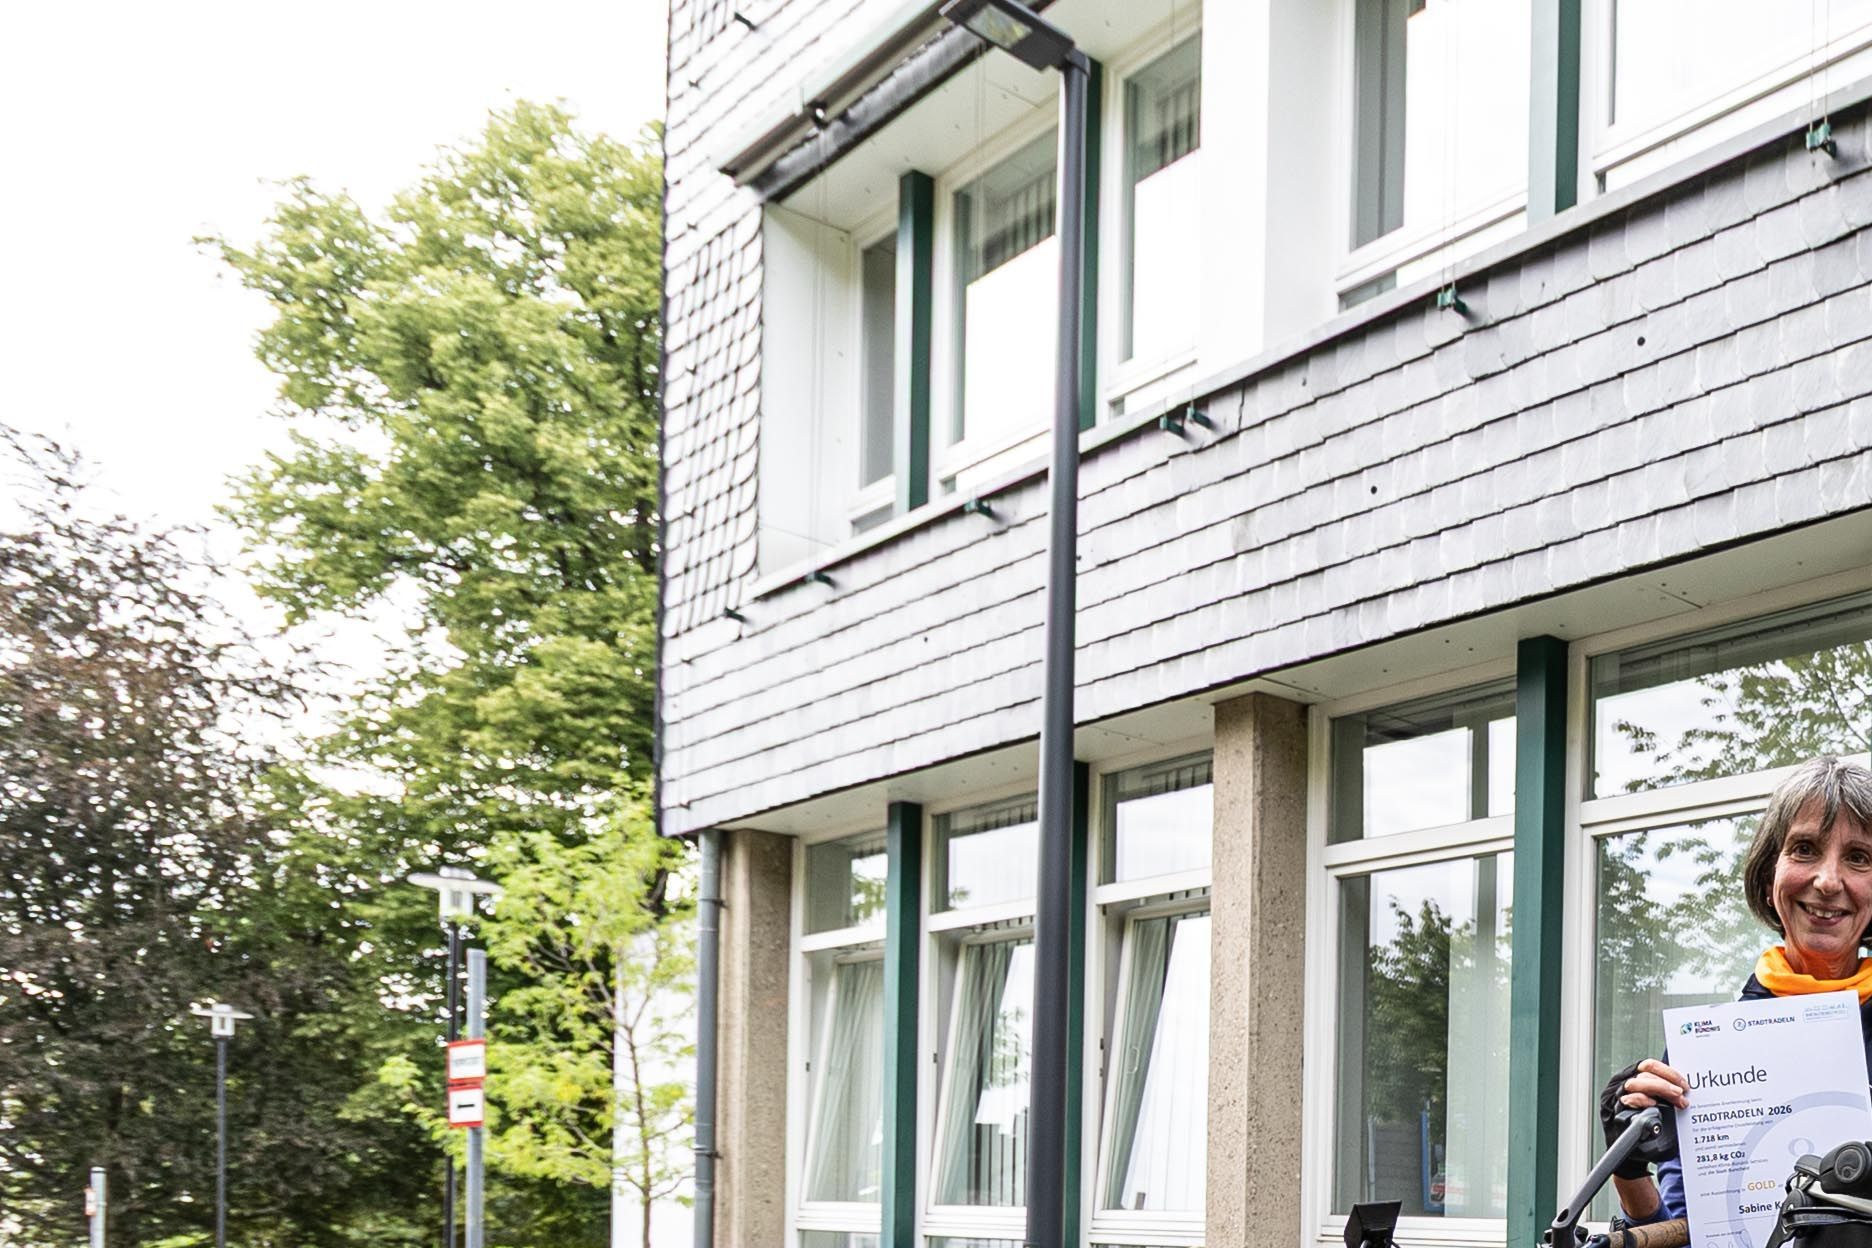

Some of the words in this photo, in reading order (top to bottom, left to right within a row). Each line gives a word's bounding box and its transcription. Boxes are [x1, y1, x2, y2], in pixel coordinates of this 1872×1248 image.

[1747, 1016, 1796, 1027] STADTRADELN
[1687, 1065, 1768, 1090] Urkunde
[1691, 1107, 1764, 1125] STADTRADELN
[1768, 1104, 1793, 1116] 2026
[1717, 1133, 1730, 1141] km
[1719, 1152, 1729, 1161] kg
[1747, 1180, 1776, 1191] GOLD
[1738, 1202, 1773, 1214] Sabine
